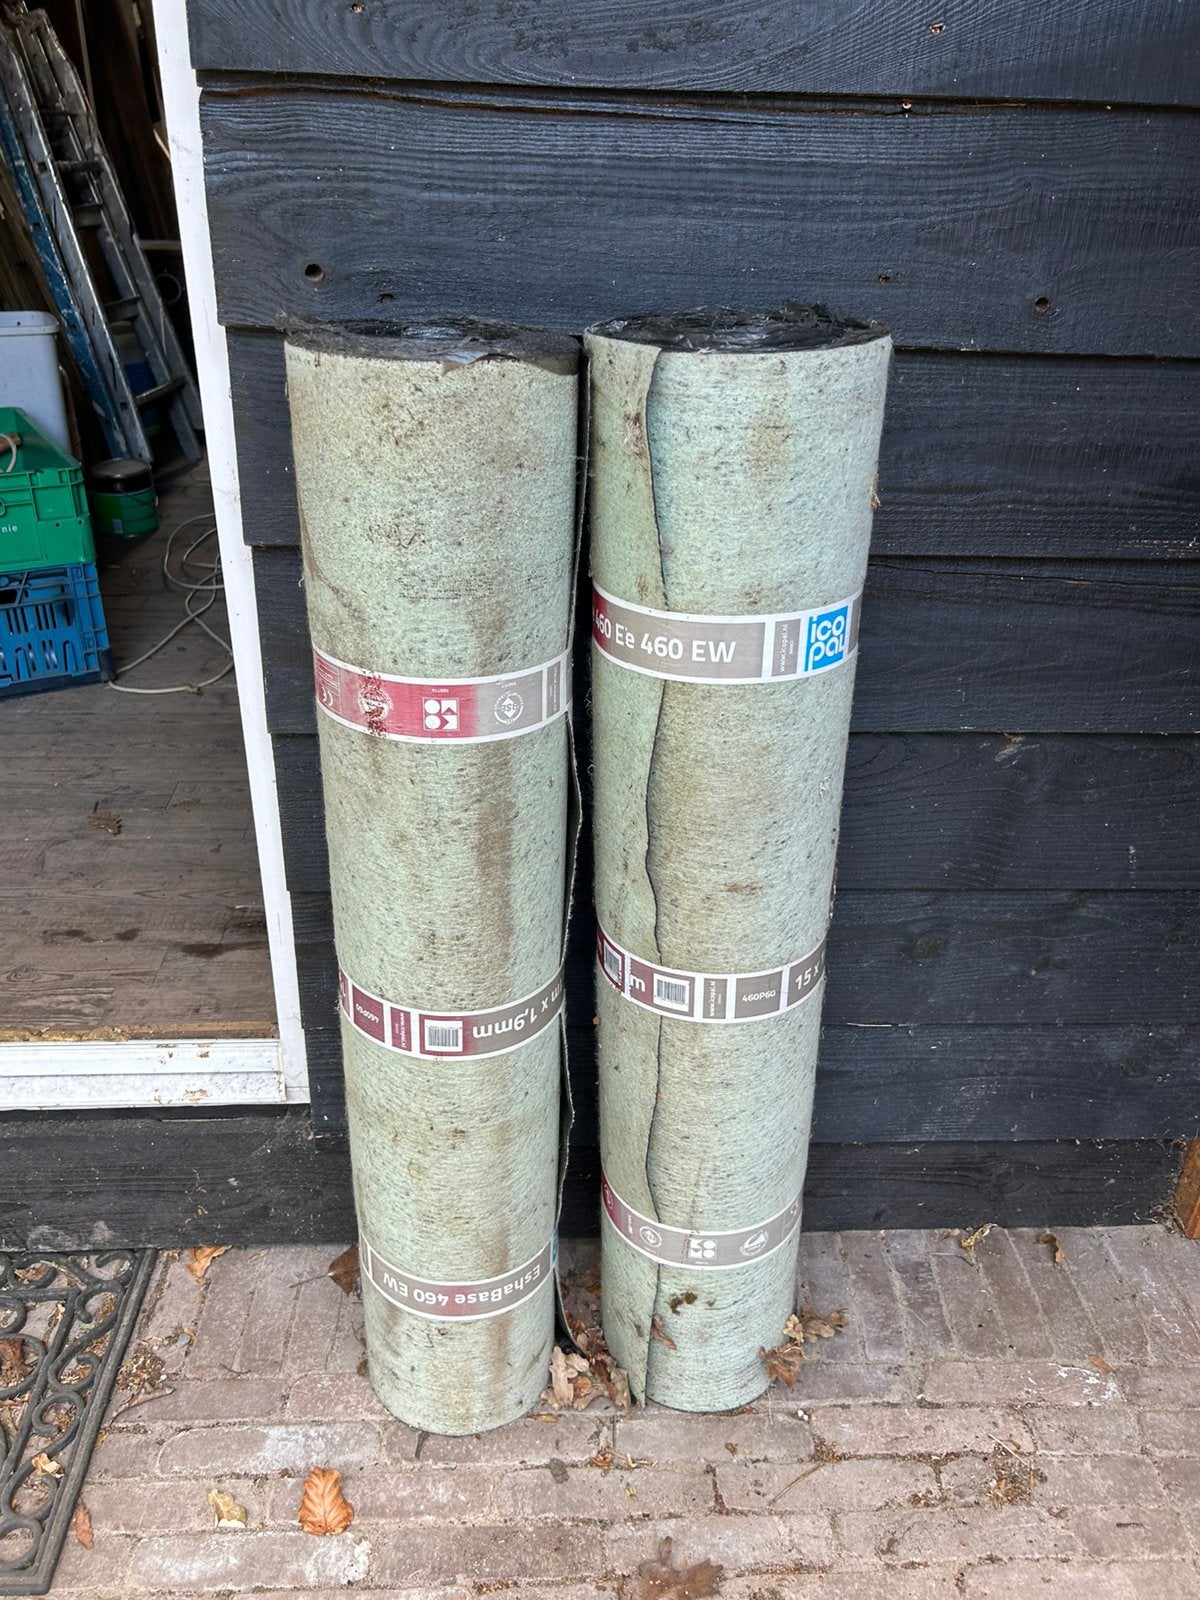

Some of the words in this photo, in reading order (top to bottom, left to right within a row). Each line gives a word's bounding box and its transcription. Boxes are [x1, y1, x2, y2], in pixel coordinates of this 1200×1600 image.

[640, 633, 684, 660] 460
[691, 640, 737, 663] EW
[795, 967, 812, 990] 15
[742, 989, 776, 1003] 460P60
[472, 1008, 538, 1039] 1,9mm
[383, 1271, 409, 1297] EW
[454, 1264, 541, 1304] EshaBase
[413, 1289, 449, 1306] 460
